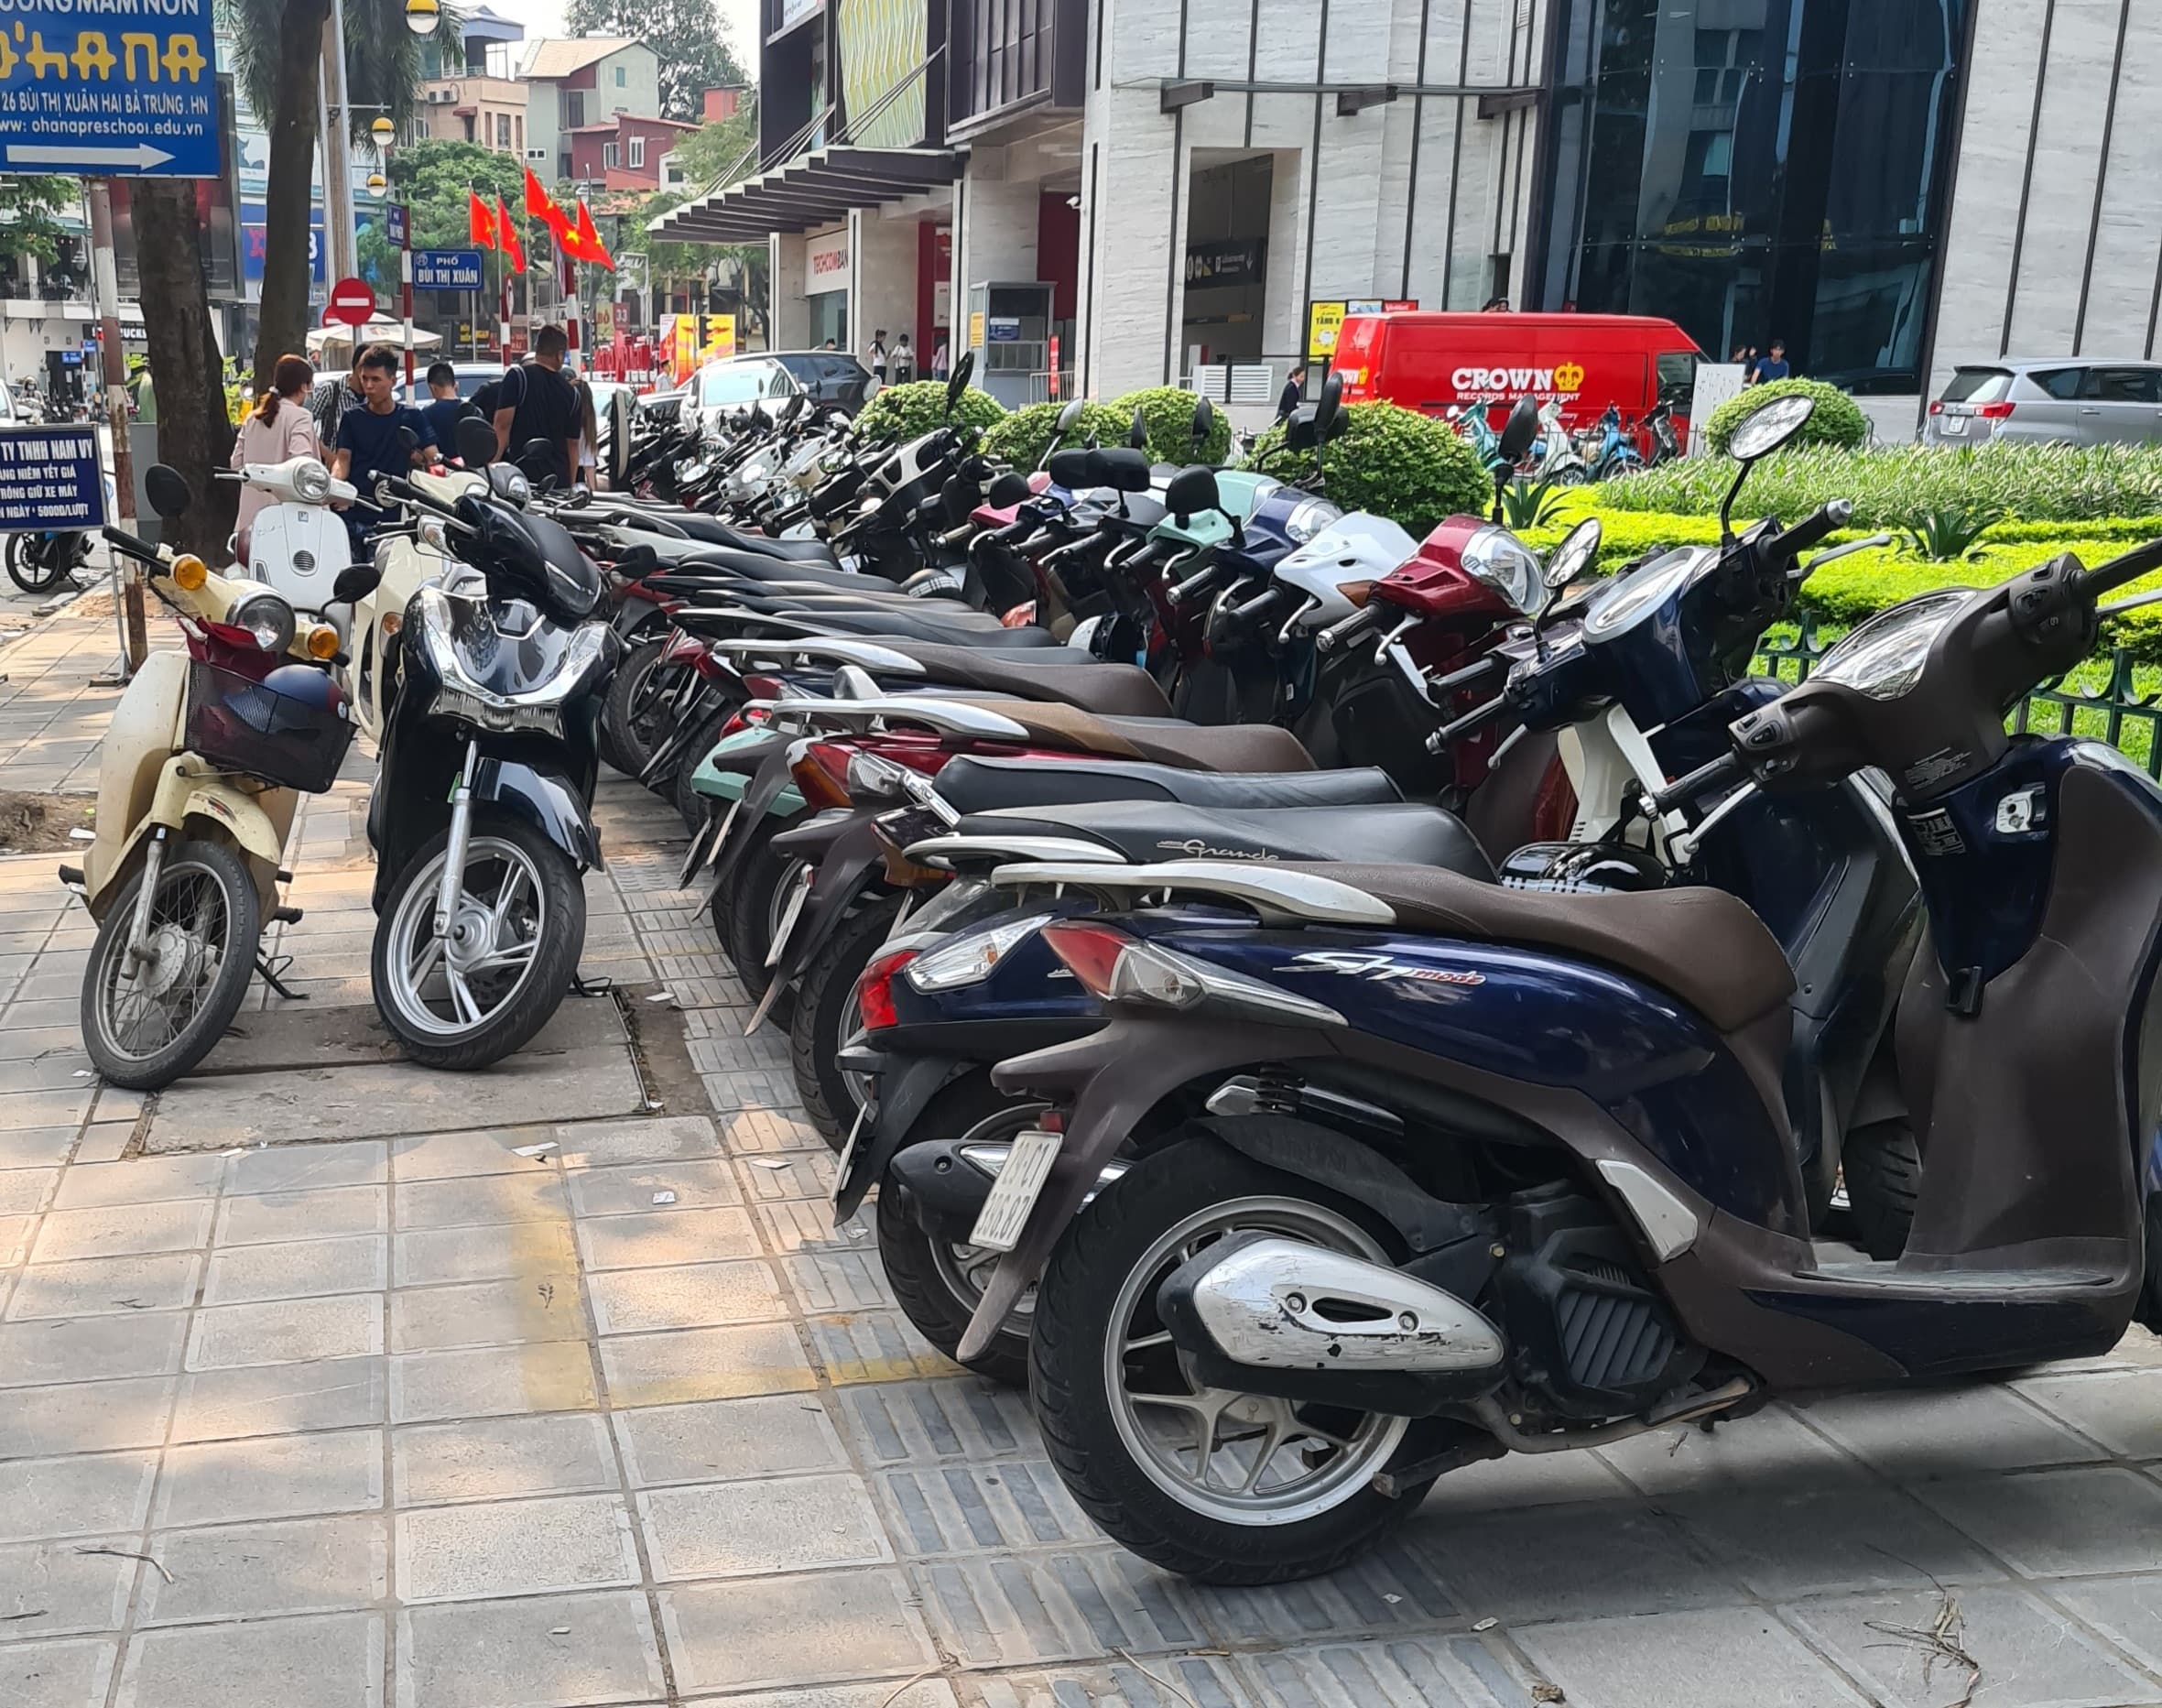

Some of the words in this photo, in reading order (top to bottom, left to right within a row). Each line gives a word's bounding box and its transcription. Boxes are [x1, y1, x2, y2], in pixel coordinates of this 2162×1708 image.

[2, 92, 16, 112] 26
[19, 87, 39, 112] BÙI
[41, 92, 61, 117] THỊ
[64, 88, 99, 113] XUÂN
[101, 92, 122, 114] HAI
[125, 88, 141, 114] BÀ
[190, 94, 209, 115] HN
[436, 255, 459, 266] PHỐ
[813, 248, 849, 276] TECHCOMBAN
[418, 267, 434, 284] BÙI
[435, 269, 451, 287] THỊ
[452, 267, 478, 284] XUÂN
[1451, 367, 1554, 391] CROWN
[1456, 392, 1505, 400] RECORDS
[1, 441, 14, 461] TY
[50, 440, 77, 460] NAM
[78, 439, 92, 459] VY
[60, 463, 76, 478] GIÁ
[0, 485, 25, 499] RÔNG
[44, 485, 56, 497] XE
[58, 484, 77, 497] MÁY
[1157, 839, 1279, 862] Grande
[1411, 968, 1487, 986] mode
